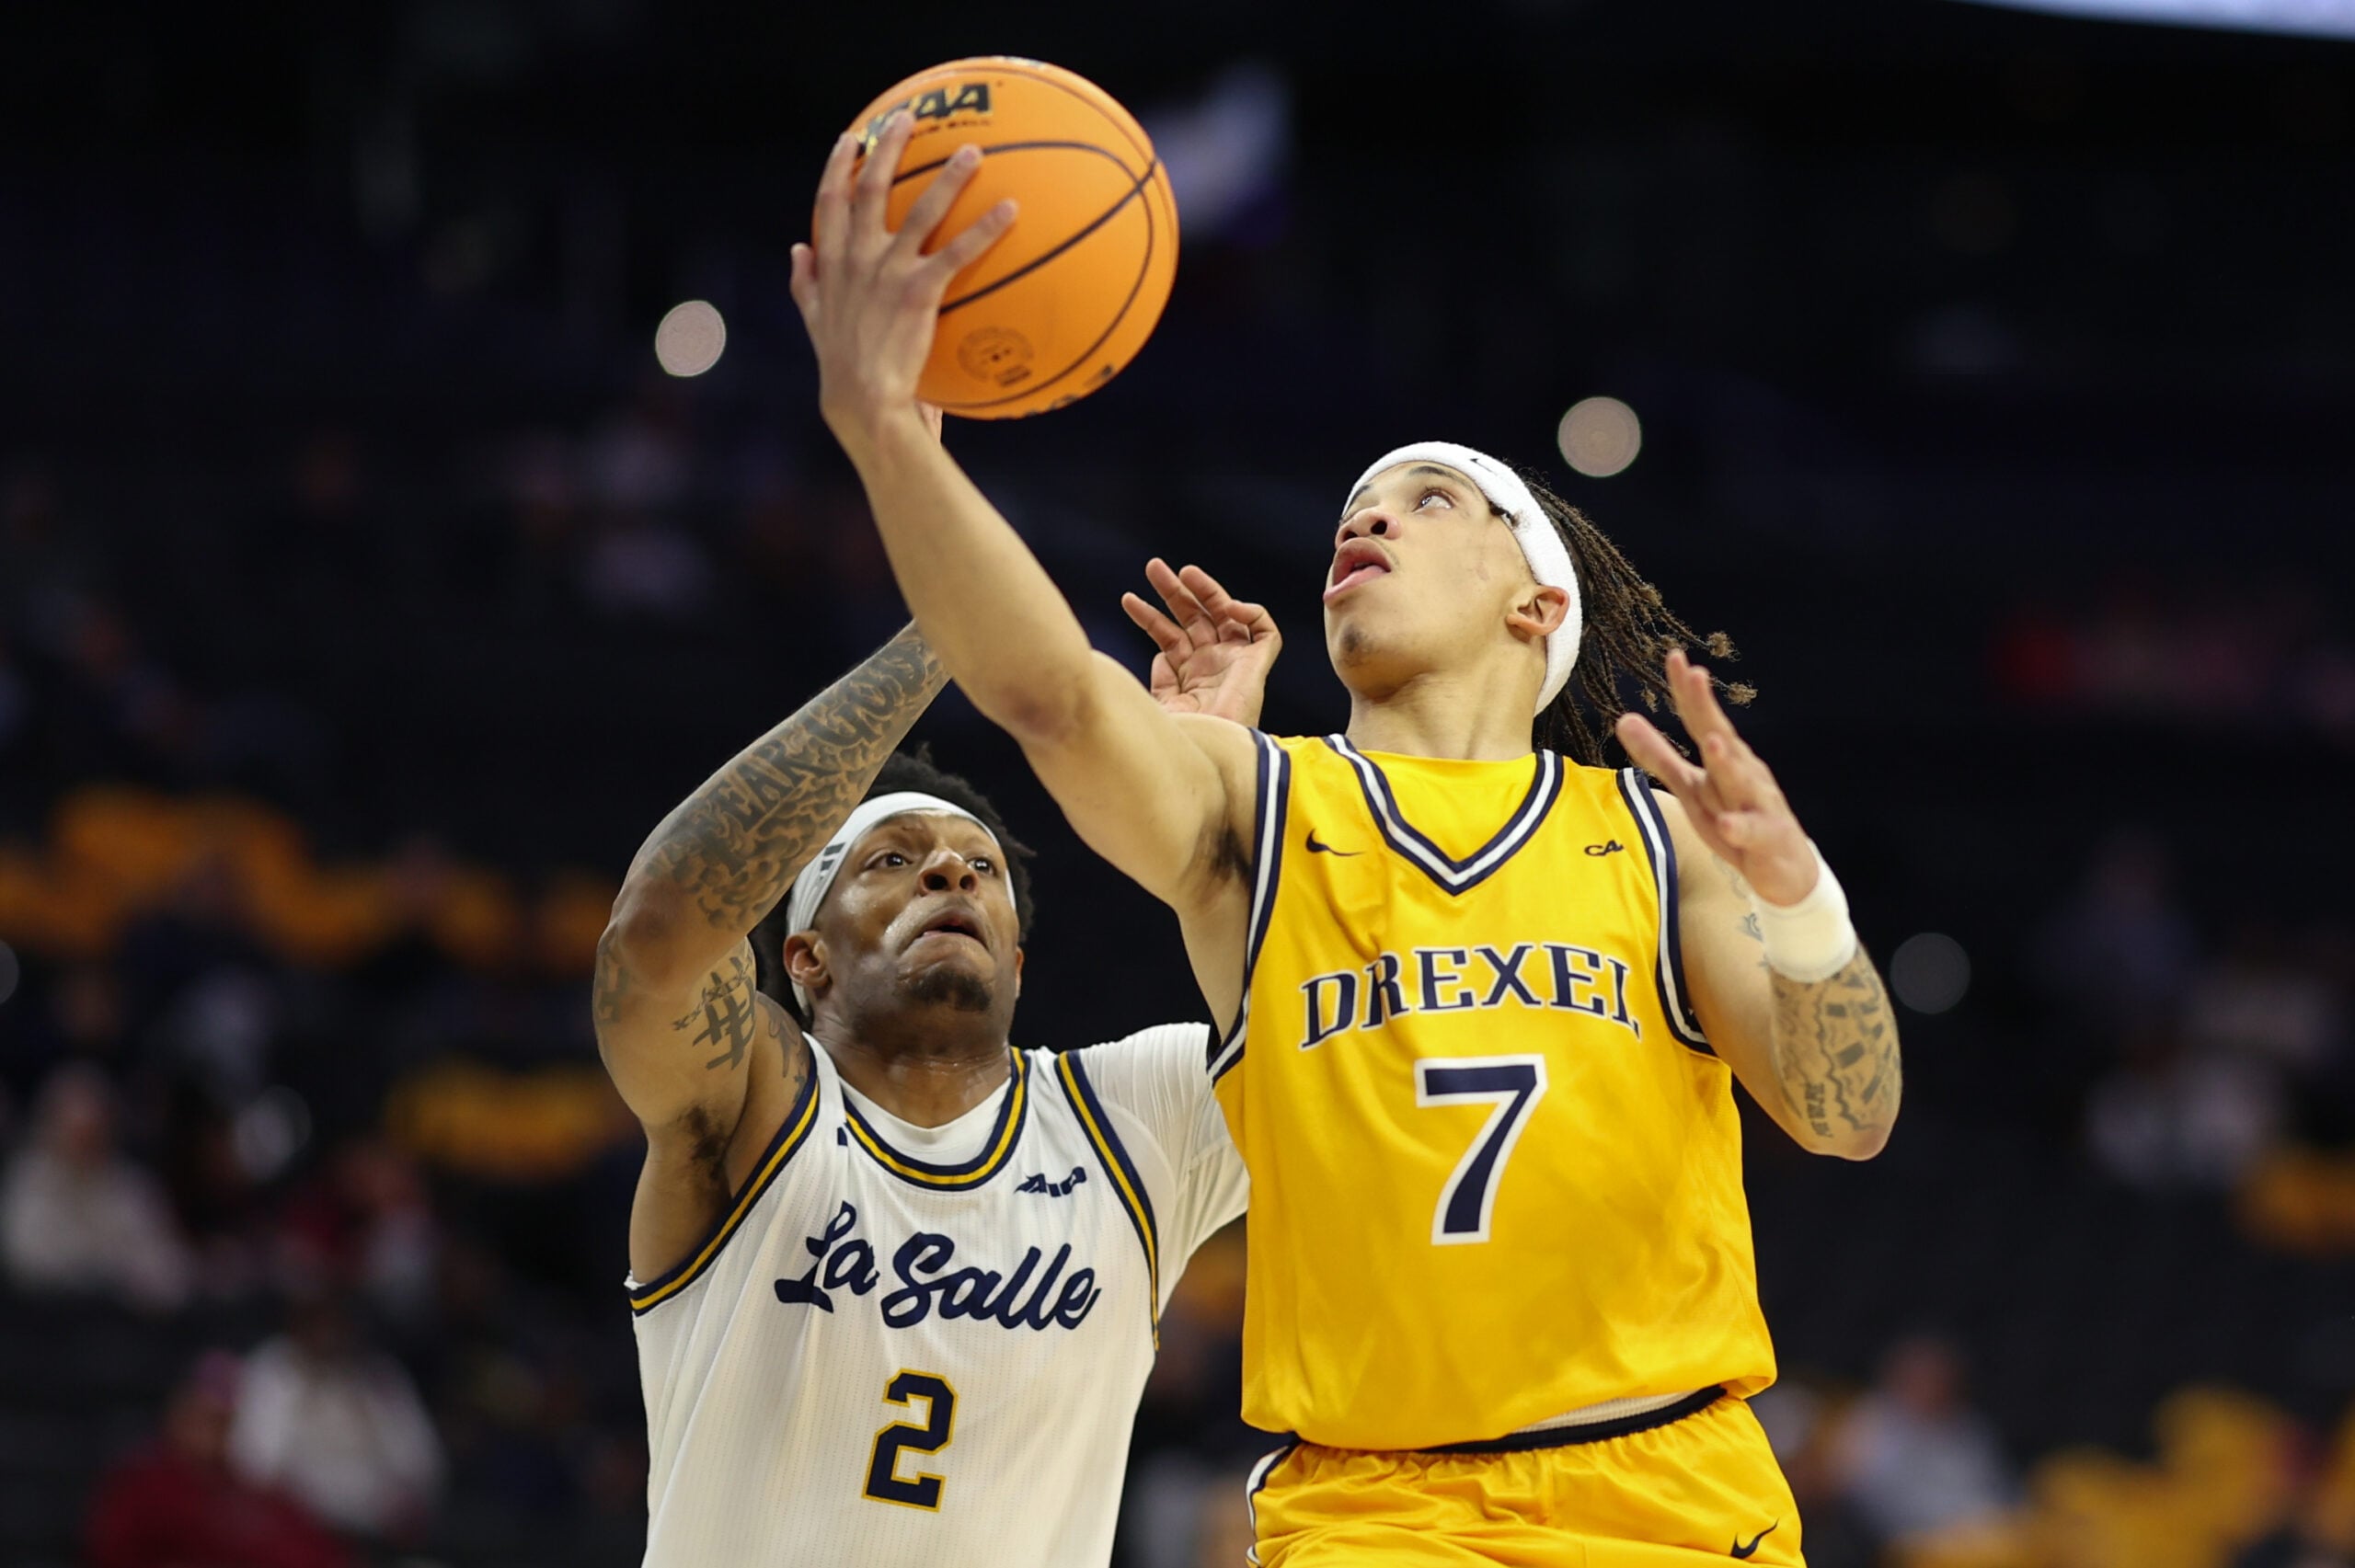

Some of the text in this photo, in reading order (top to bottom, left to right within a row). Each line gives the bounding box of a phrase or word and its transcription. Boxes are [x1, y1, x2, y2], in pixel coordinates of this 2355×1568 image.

[1297, 941, 1641, 1049] DREXEL
[1414, 1053, 1548, 1246] 7
[774, 1200, 1101, 1331] La Salle
[861, 1368, 959, 1513] 2
